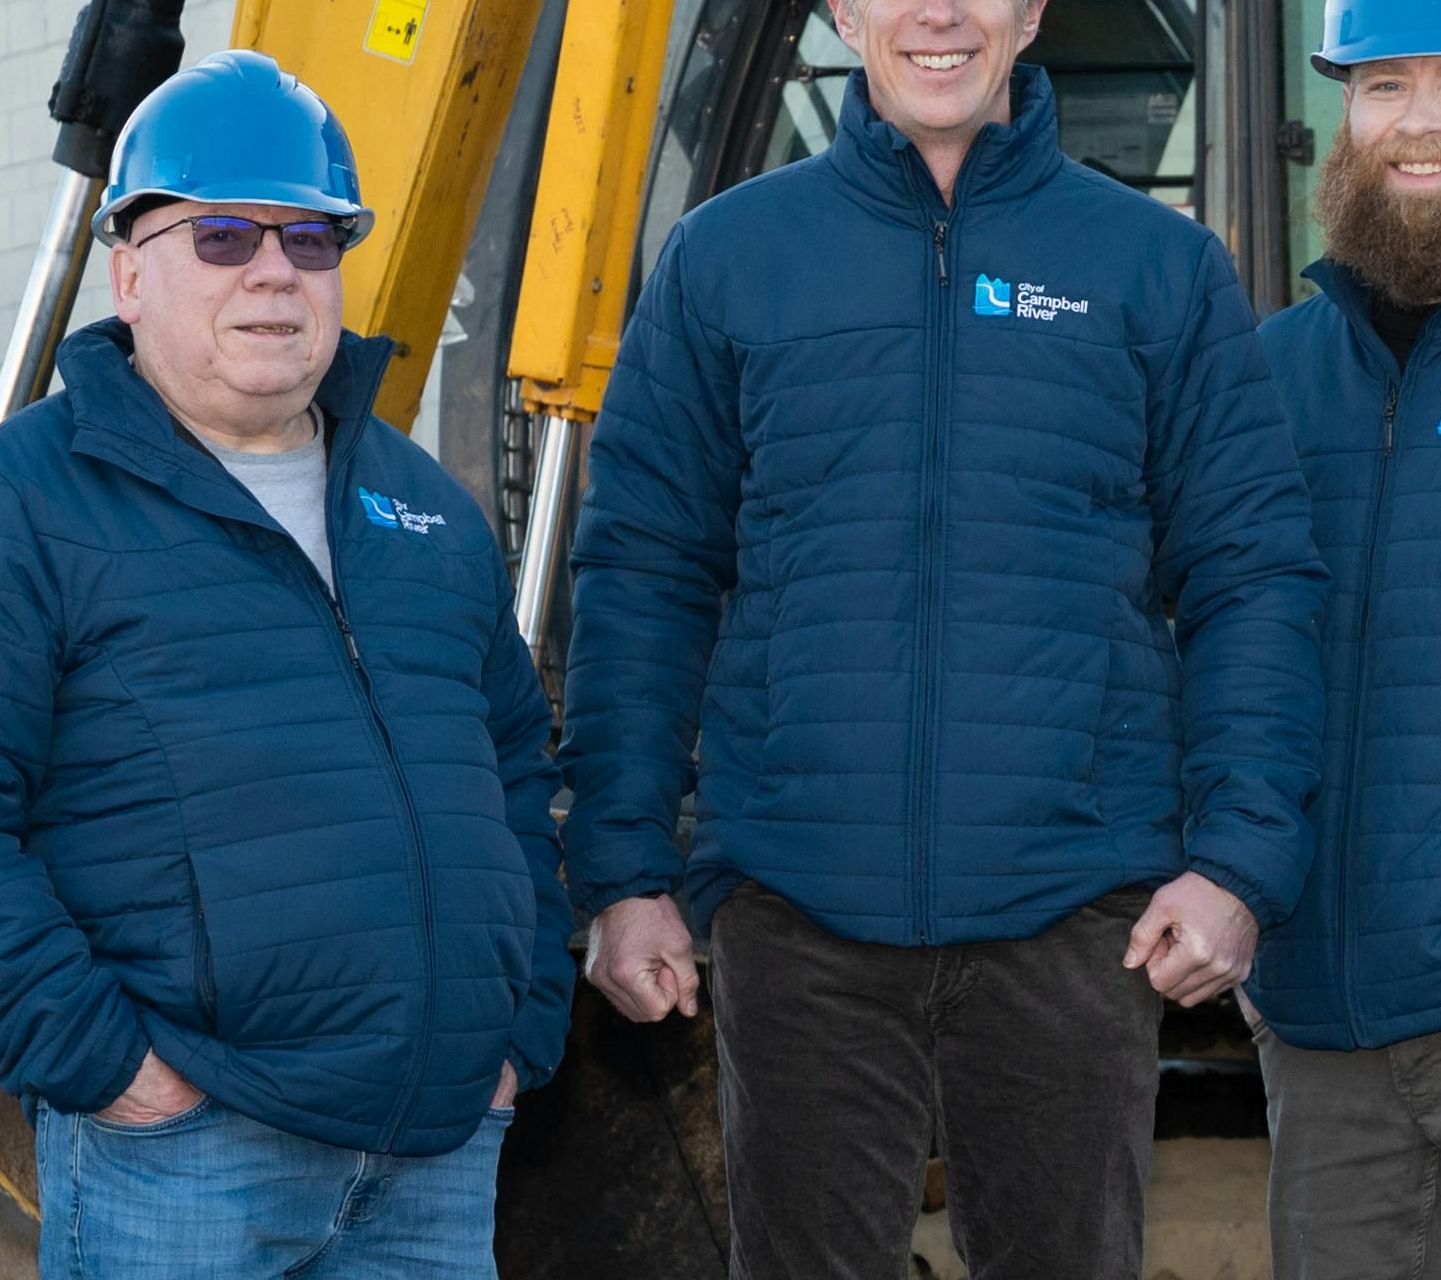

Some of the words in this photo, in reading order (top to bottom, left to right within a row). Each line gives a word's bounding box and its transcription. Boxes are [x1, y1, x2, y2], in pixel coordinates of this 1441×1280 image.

[1018, 283, 1036, 294] City
[1017, 291, 1089, 314] Campbell
[1016, 303, 1058, 321] River
